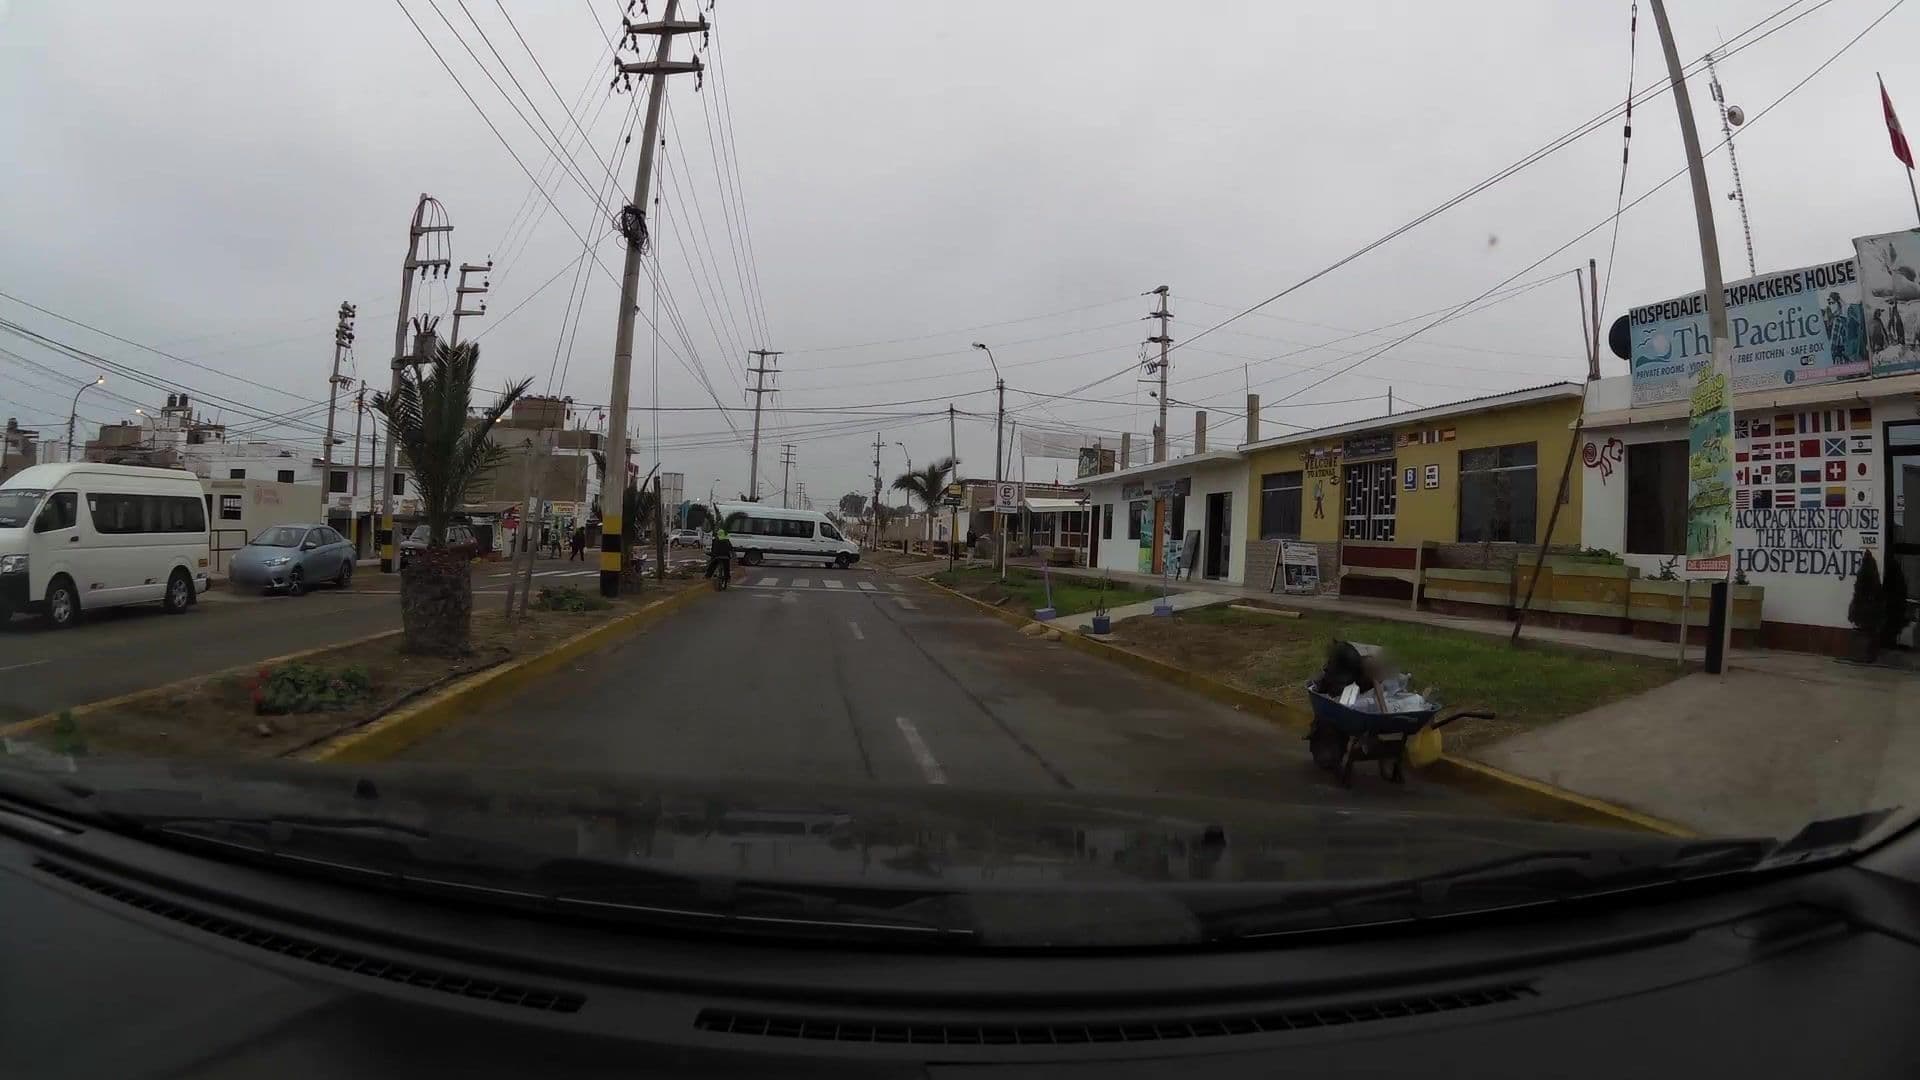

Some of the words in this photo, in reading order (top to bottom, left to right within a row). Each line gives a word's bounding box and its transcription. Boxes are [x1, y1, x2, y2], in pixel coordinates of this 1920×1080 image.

[1630, 295, 1702, 326] HOSPEDAJE
[1704, 272, 1803, 311] CKPACKERS
[1805, 261, 1856, 291] HOUSE
[1673, 322, 1712, 358] Th
[1731, 307, 1821, 349] Pacific
[1636, 367, 1660, 379] PRIVATE
[1661, 364, 1685, 376] ROOMS
[1738, 352, 1753, 363] FREE
[1755, 348, 1785, 360] KITCHEN
[1790, 344, 1807, 355] SAFE
[1809, 342, 1825, 353] BOX
[1004, 487, 1011, 498] E
[1829, 508, 1880, 529] HOUSE
[1756, 528, 1785, 549] THE
[1790, 529, 1843, 549] PACIFIC
[1862, 536, 1877, 545] VISA
[1736, 548, 1863, 581] HOSPEDAJE
